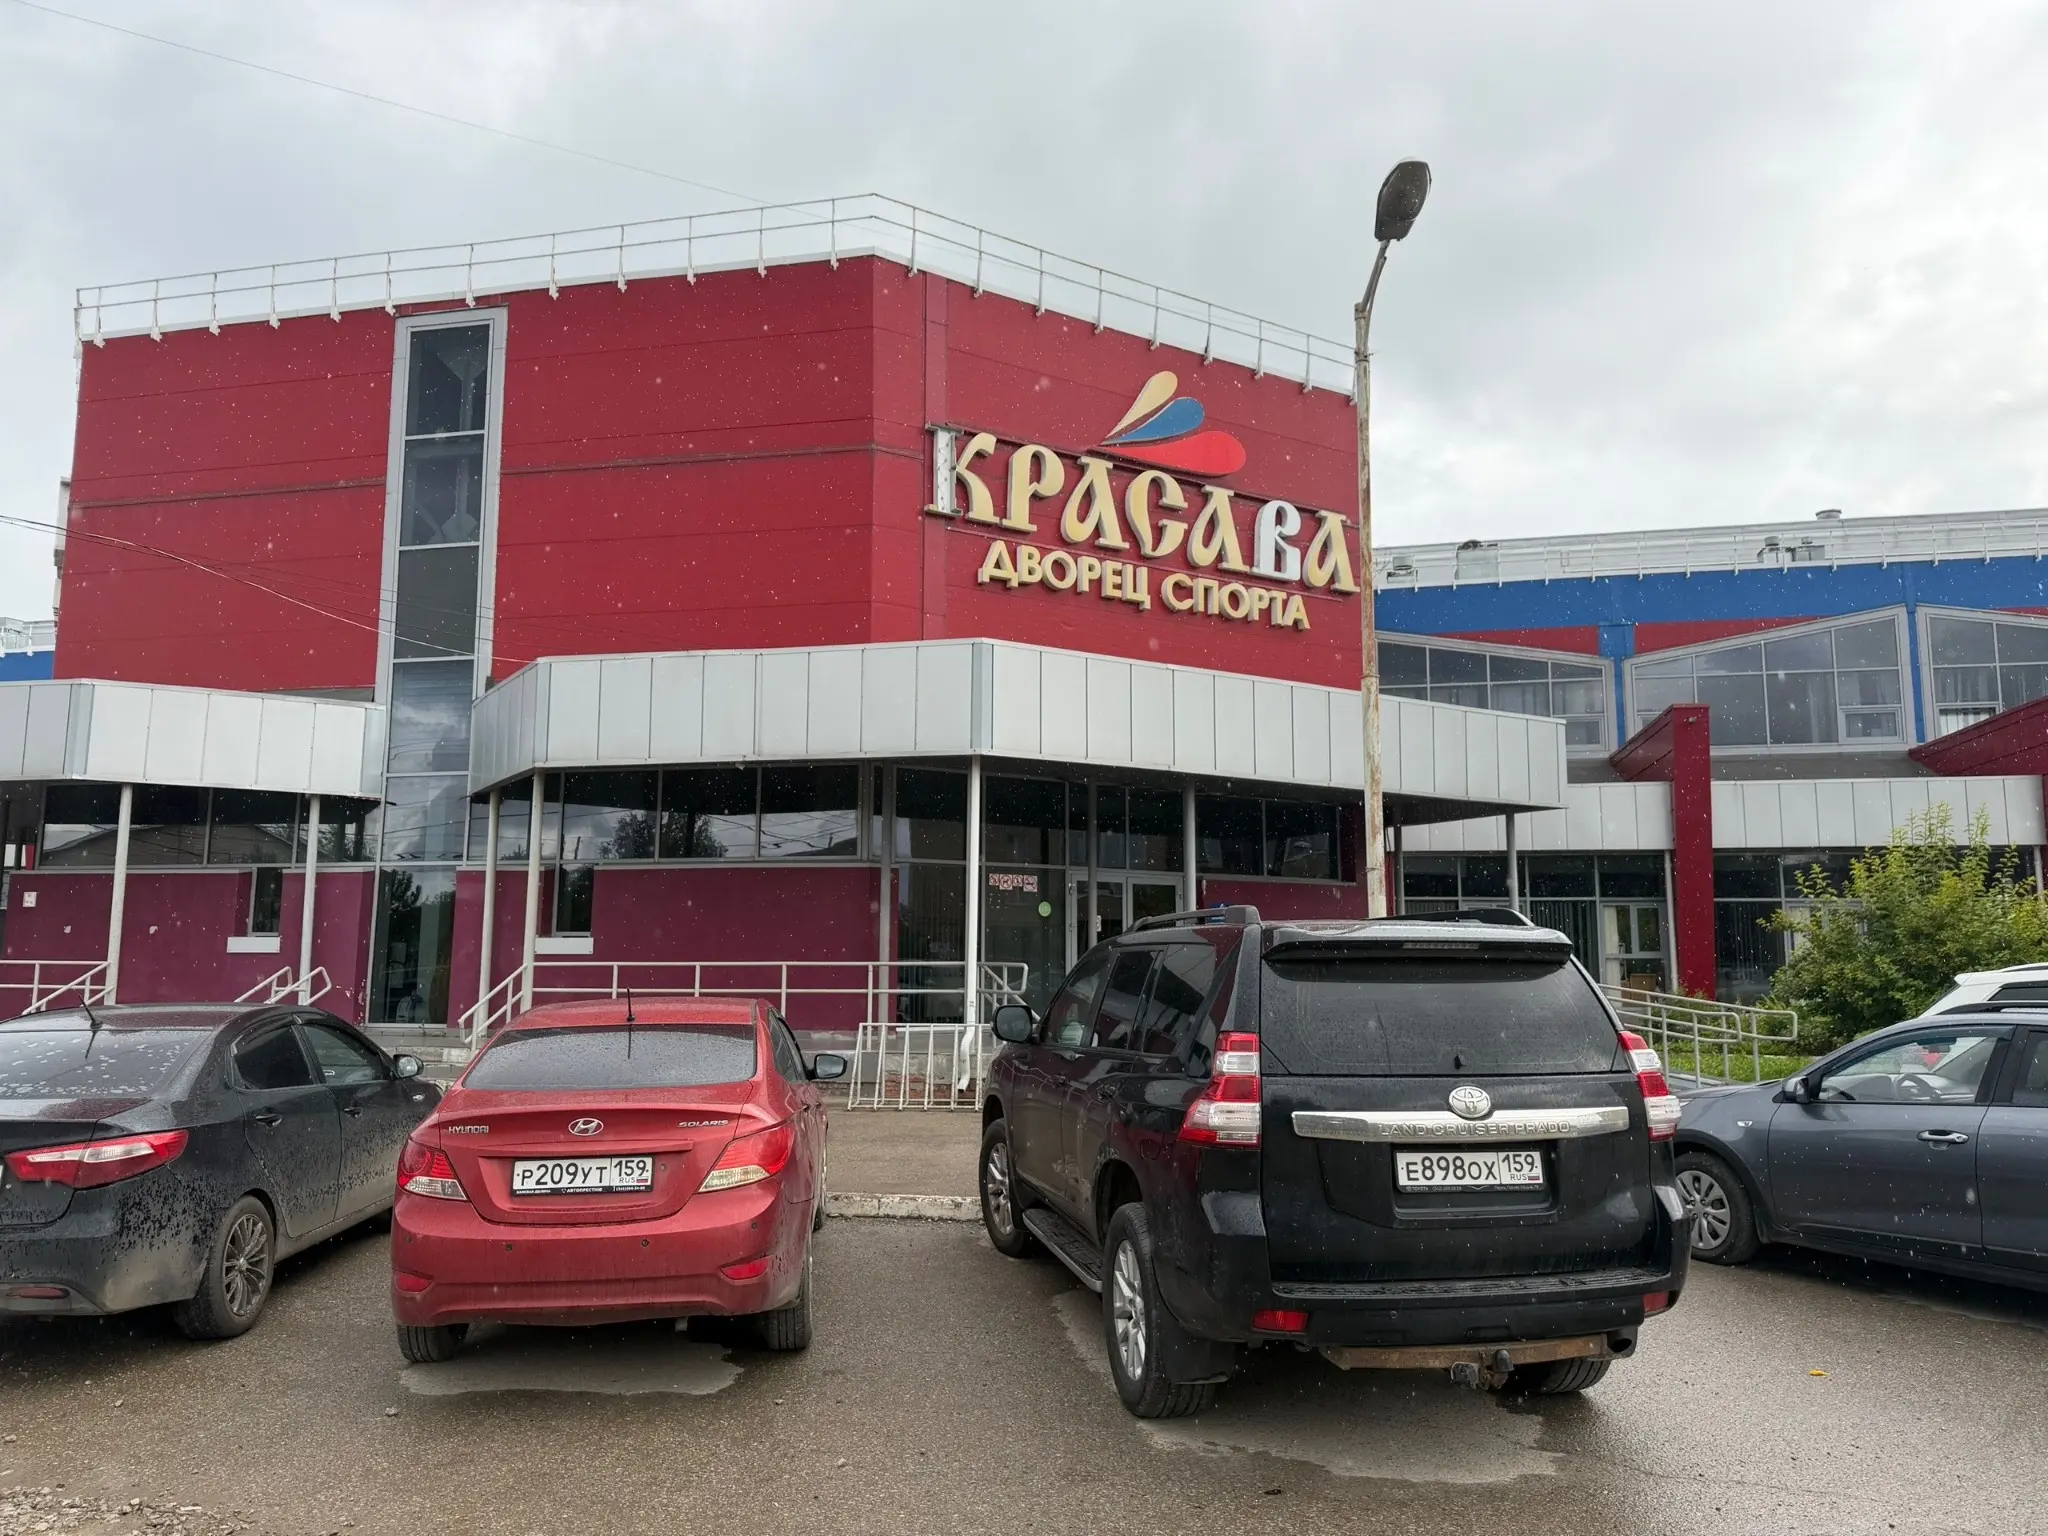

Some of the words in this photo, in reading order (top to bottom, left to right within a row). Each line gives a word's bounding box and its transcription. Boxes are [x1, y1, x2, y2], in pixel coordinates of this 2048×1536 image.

[923, 421, 1361, 594] КРАСАВА
[977, 539, 1151, 611] ДВОРЕЦ
[1160, 573, 1311, 631] СПОРТА
[448, 1125, 490, 1134] HYUNDAI
[677, 1119, 729, 1128] SOLARIS
[1379, 1123, 1427, 1136] LAND
[1431, 1122, 1511, 1136] CRUISER
[1515, 1120, 1571, 1134] PRADO
[613, 1159, 647, 1178] 159
[1501, 1153, 1536, 1173] 159
[618, 1176, 636, 1184] RUS
[1509, 1173, 1528, 1181] RUS
